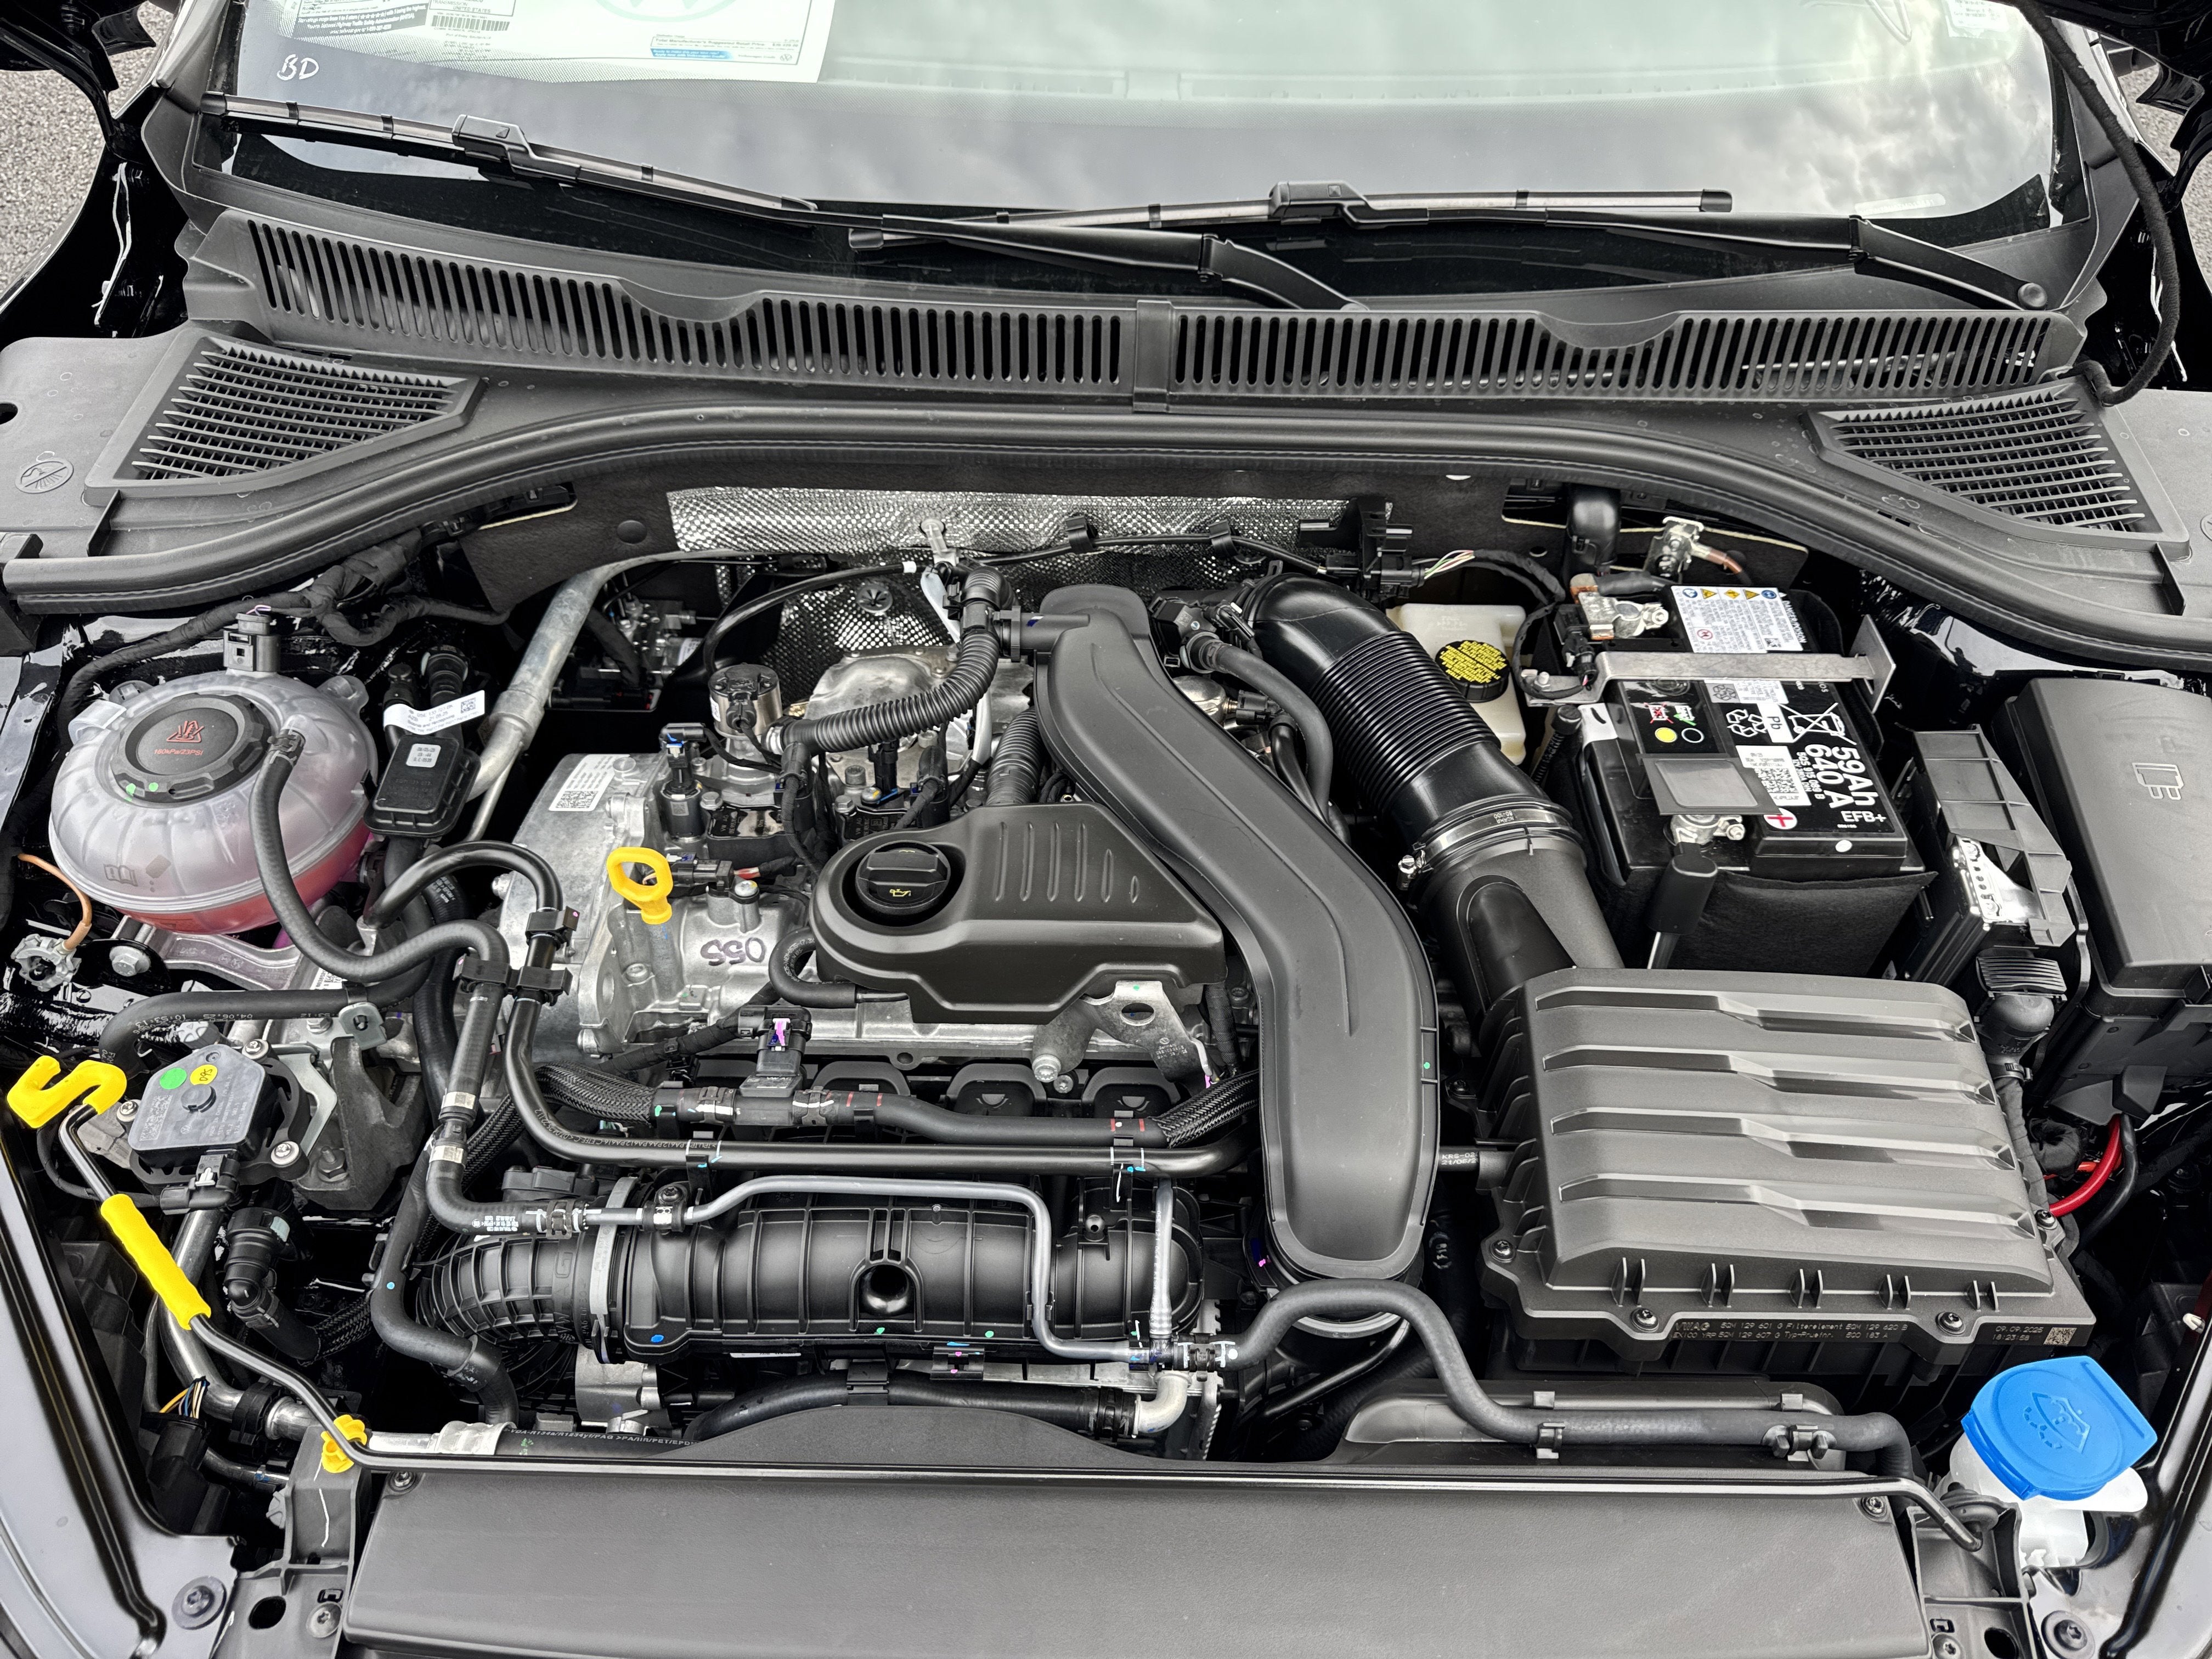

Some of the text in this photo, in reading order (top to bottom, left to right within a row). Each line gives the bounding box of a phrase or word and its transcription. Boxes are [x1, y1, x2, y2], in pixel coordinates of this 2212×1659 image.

[1766, 715, 1783, 730] Pb
[1803, 767, 1816, 778] 915
[1805, 744, 1845, 785] 640
[1832, 747, 1878, 806] 59Ah
[1824, 789, 1854, 809] A
[1841, 810, 1887, 823] EFB+
